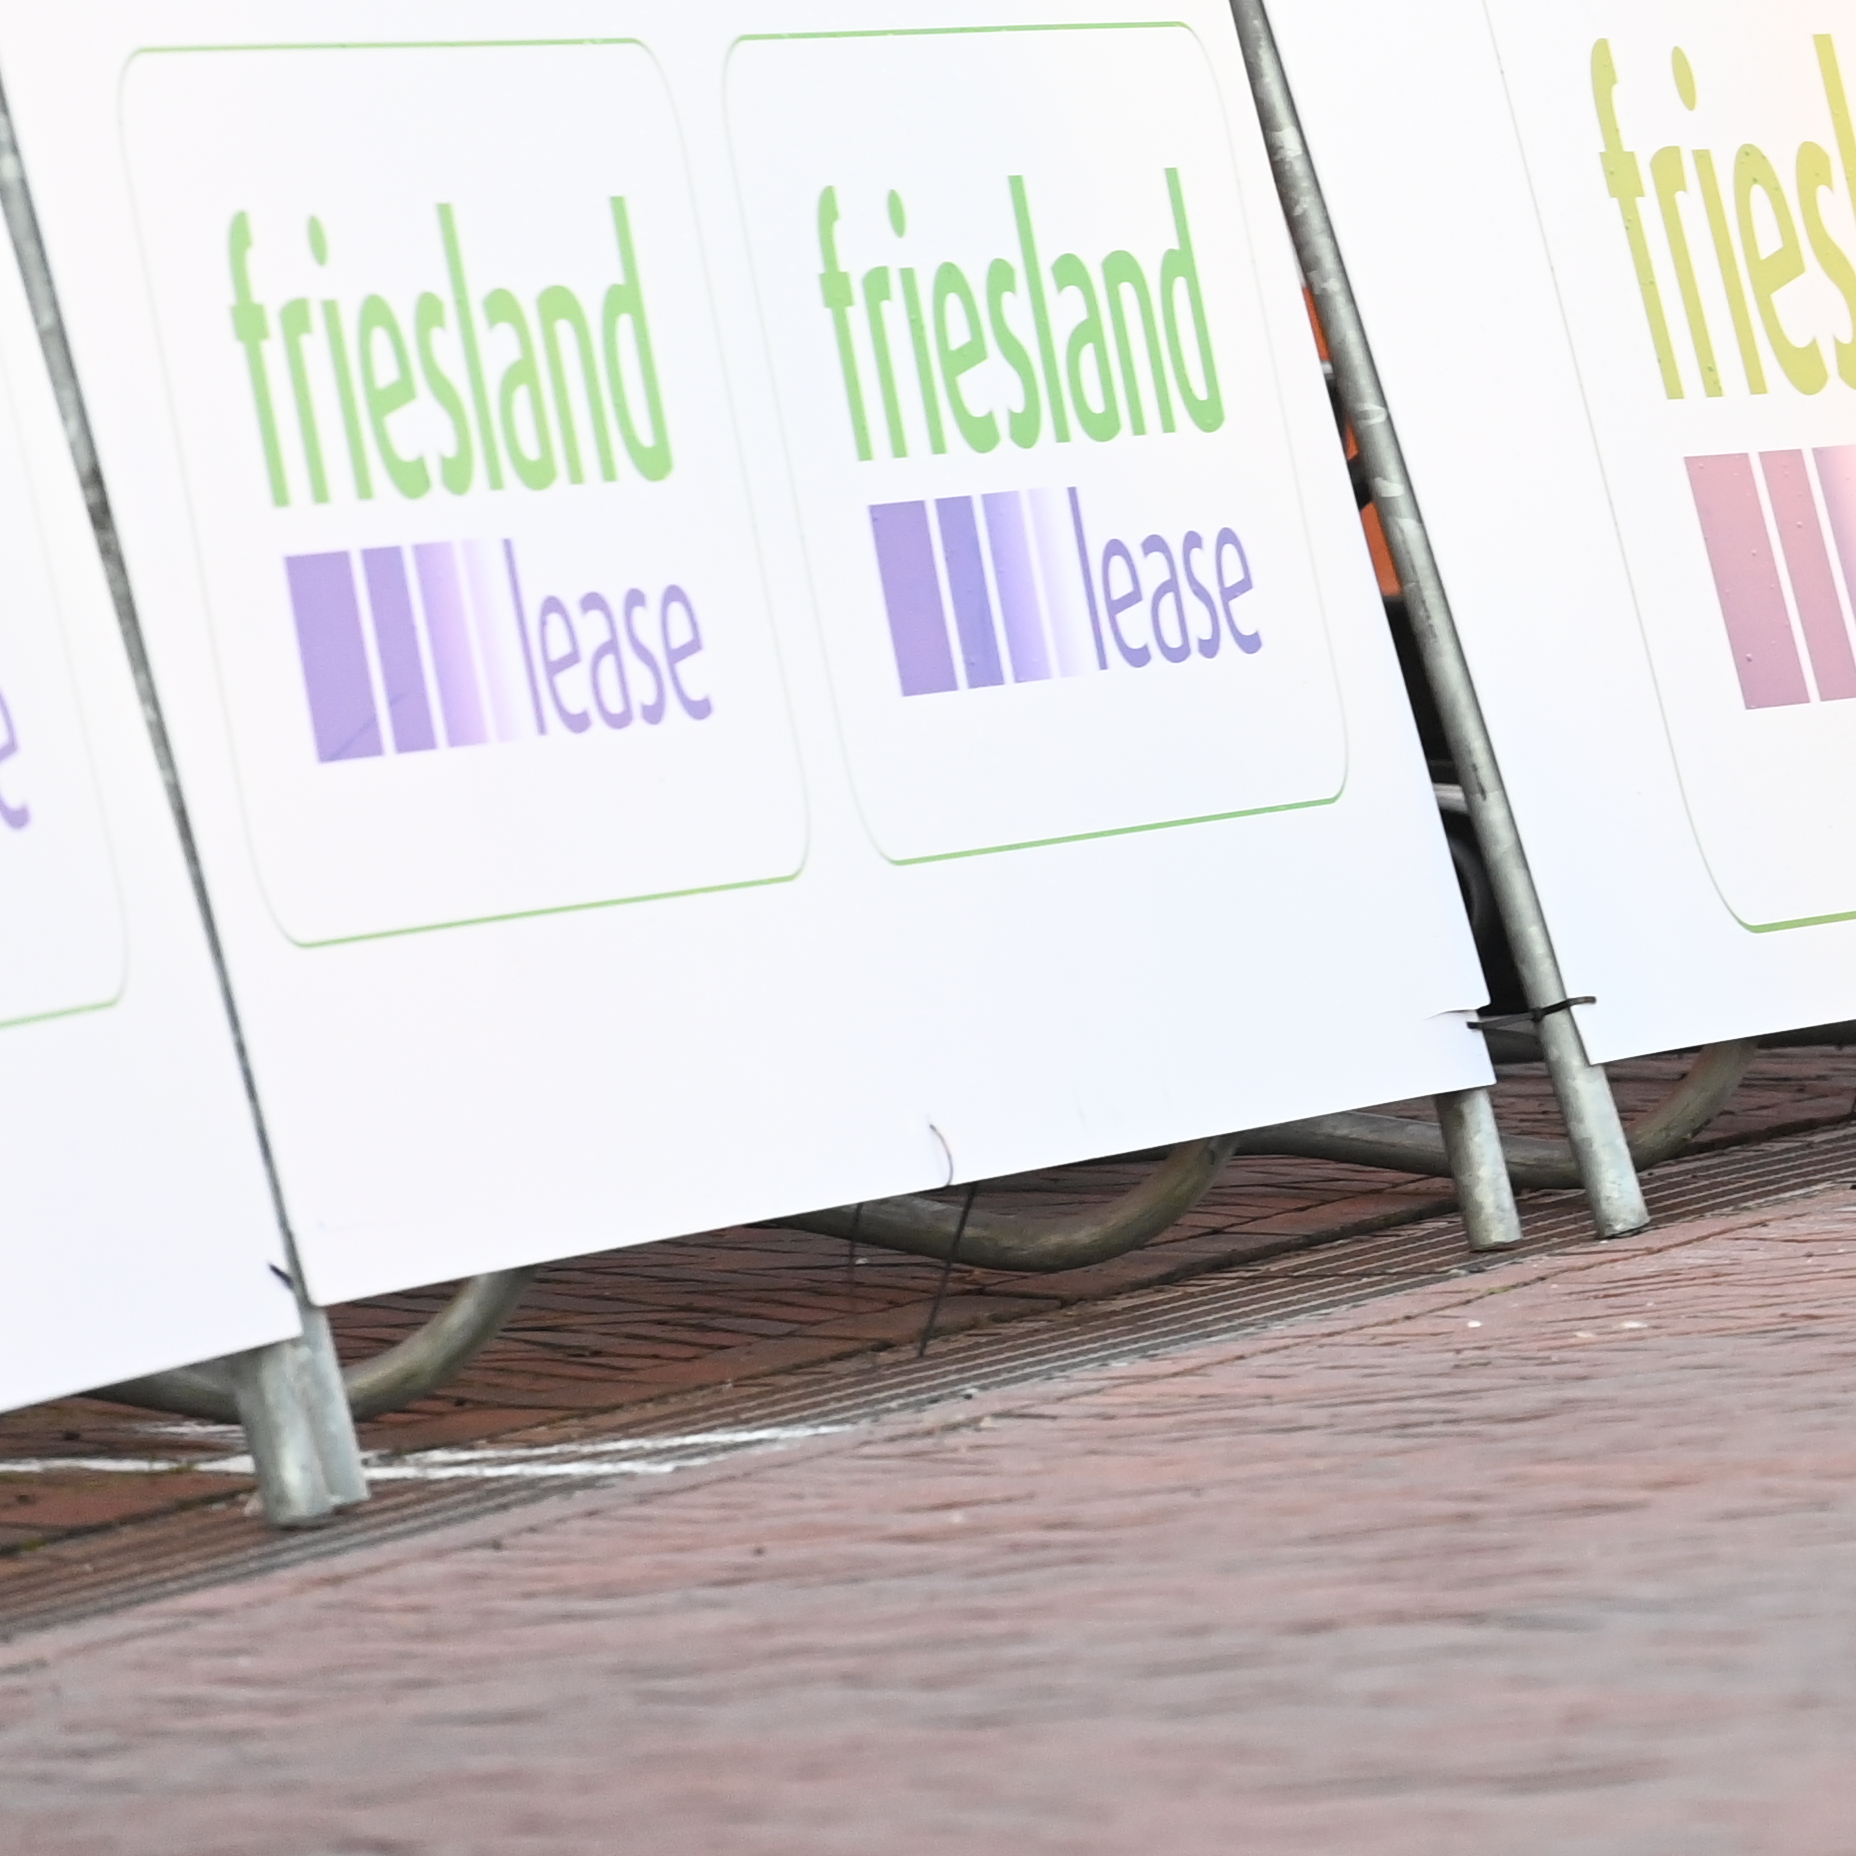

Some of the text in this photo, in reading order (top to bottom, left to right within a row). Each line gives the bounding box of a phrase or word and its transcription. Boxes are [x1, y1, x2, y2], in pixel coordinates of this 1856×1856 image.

[226, 195, 675, 508] friesland
[816, 166, 1227, 462] friesland
[503, 537, 715, 738] lease
[1066, 485, 1265, 671] lease
